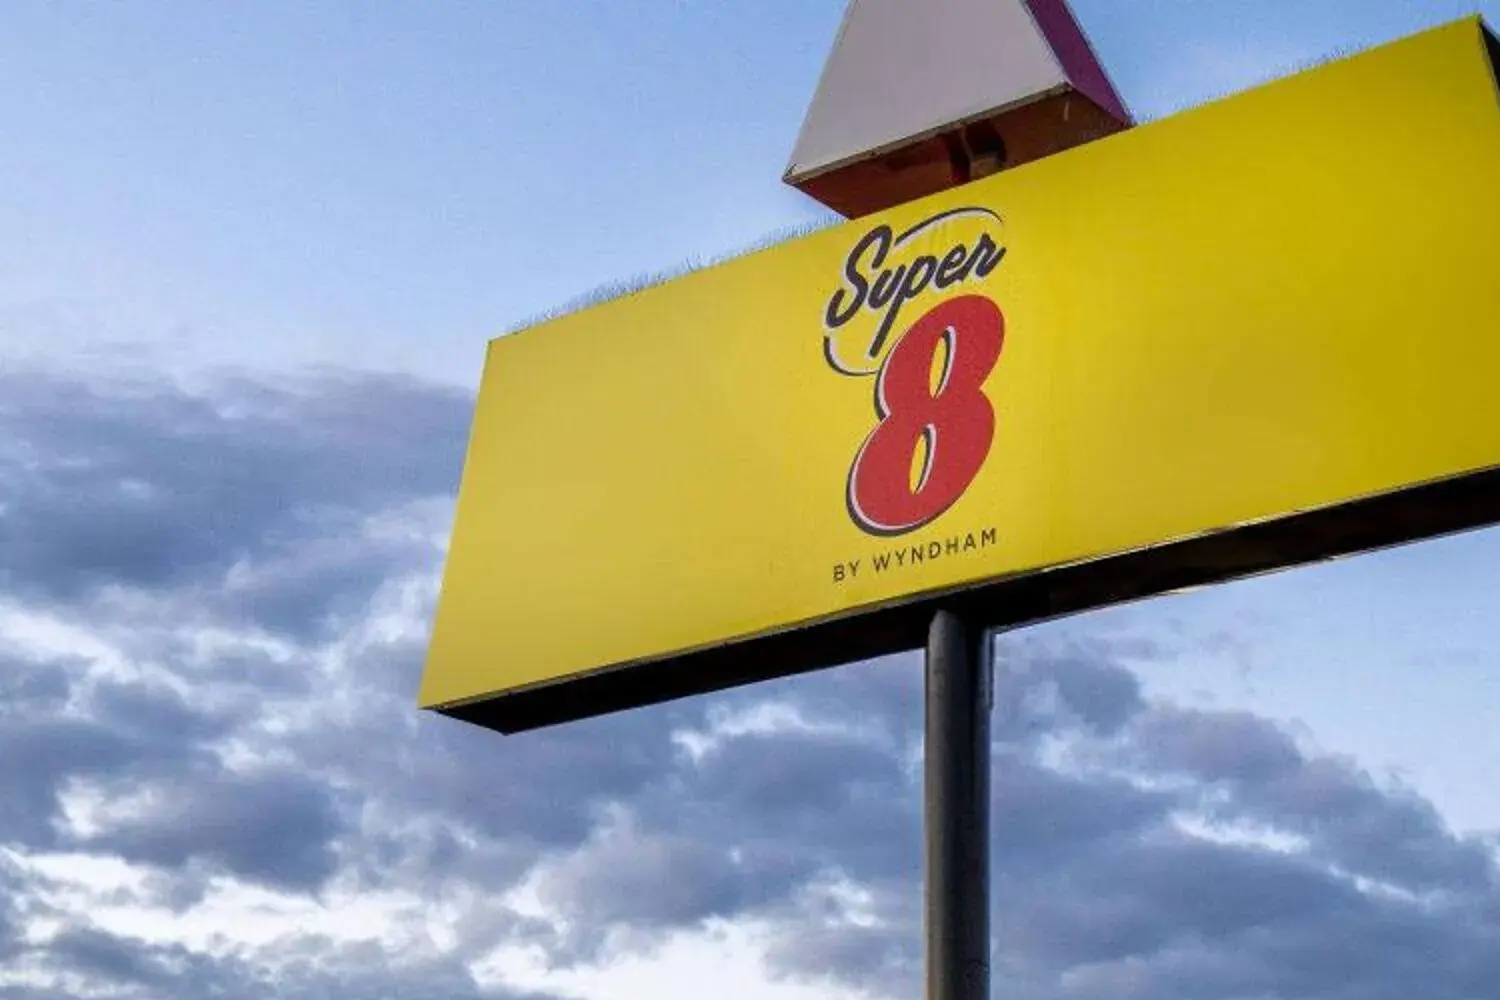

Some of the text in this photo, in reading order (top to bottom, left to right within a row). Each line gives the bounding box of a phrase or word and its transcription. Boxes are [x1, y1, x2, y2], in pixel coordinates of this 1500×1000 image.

[825, 222, 1007, 360] Super
[845, 292, 1006, 537] 8
[832, 527, 998, 583] BY WYNDHAM
